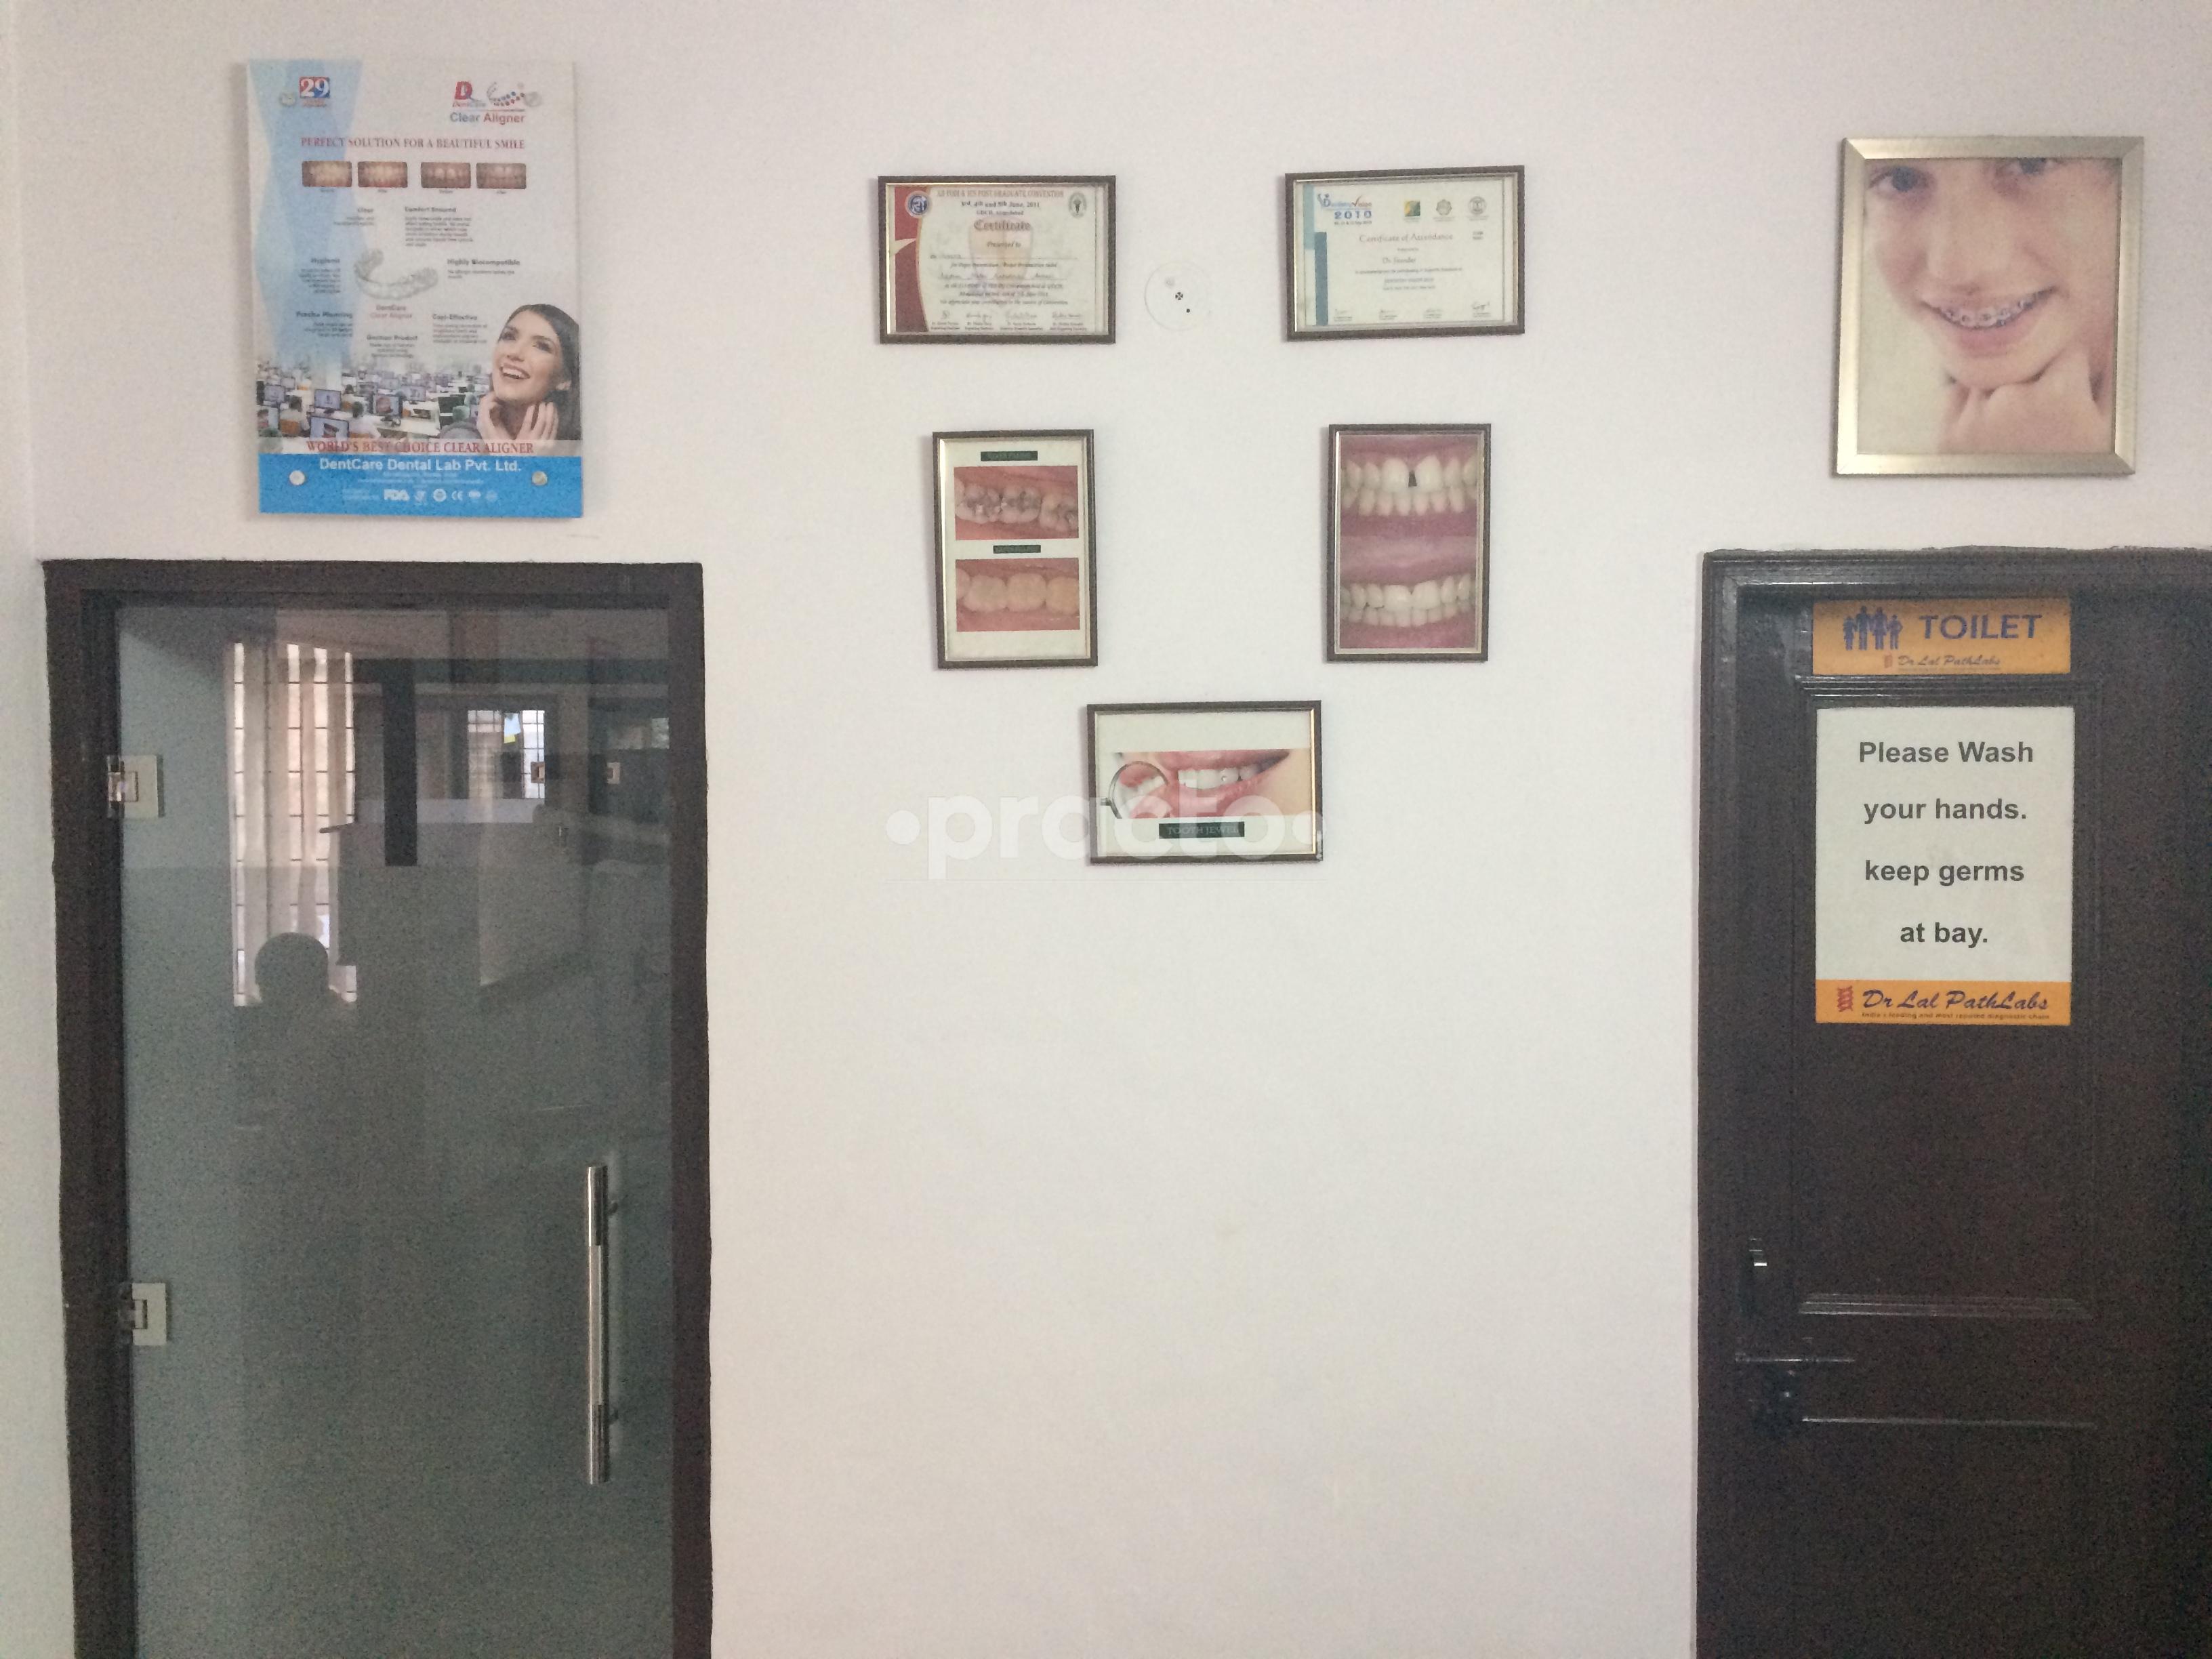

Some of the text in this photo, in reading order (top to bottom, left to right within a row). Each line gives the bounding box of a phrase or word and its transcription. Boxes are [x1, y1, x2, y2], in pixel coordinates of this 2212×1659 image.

[300, 78, 331, 98] 29
[450, 112, 526, 125] Clear Aligner
[301, 138, 525, 149] PERFECT SOLUTION FOR A BEAUTIFUL SMILE
[1334, 210, 1372, 220] 2010
[973, 219, 1031, 232] Certificate
[1359, 234, 1400, 243] Certificate
[1410, 232, 1454, 241] Attendance
[447, 258, 470, 267] Highly
[306, 441, 534, 454] WORLD'S BEST CHOICE CLEAR ALIGNER
[320, 457, 522, 472] DentCare Dental Lab Pvt. Ltd.
[1919, 613, 2043, 640] TOILET
[1898, 654, 2001, 666] Dr Lal PathLabs
[1859, 741, 2034, 763] Please Wash
[1863, 798, 2027, 825] your hands.
[1865, 859, 2025, 886] keep germs
[1900, 922, 1988, 948] at bay.
[1862, 989, 2049, 1010] Dr Lal PathLabs
